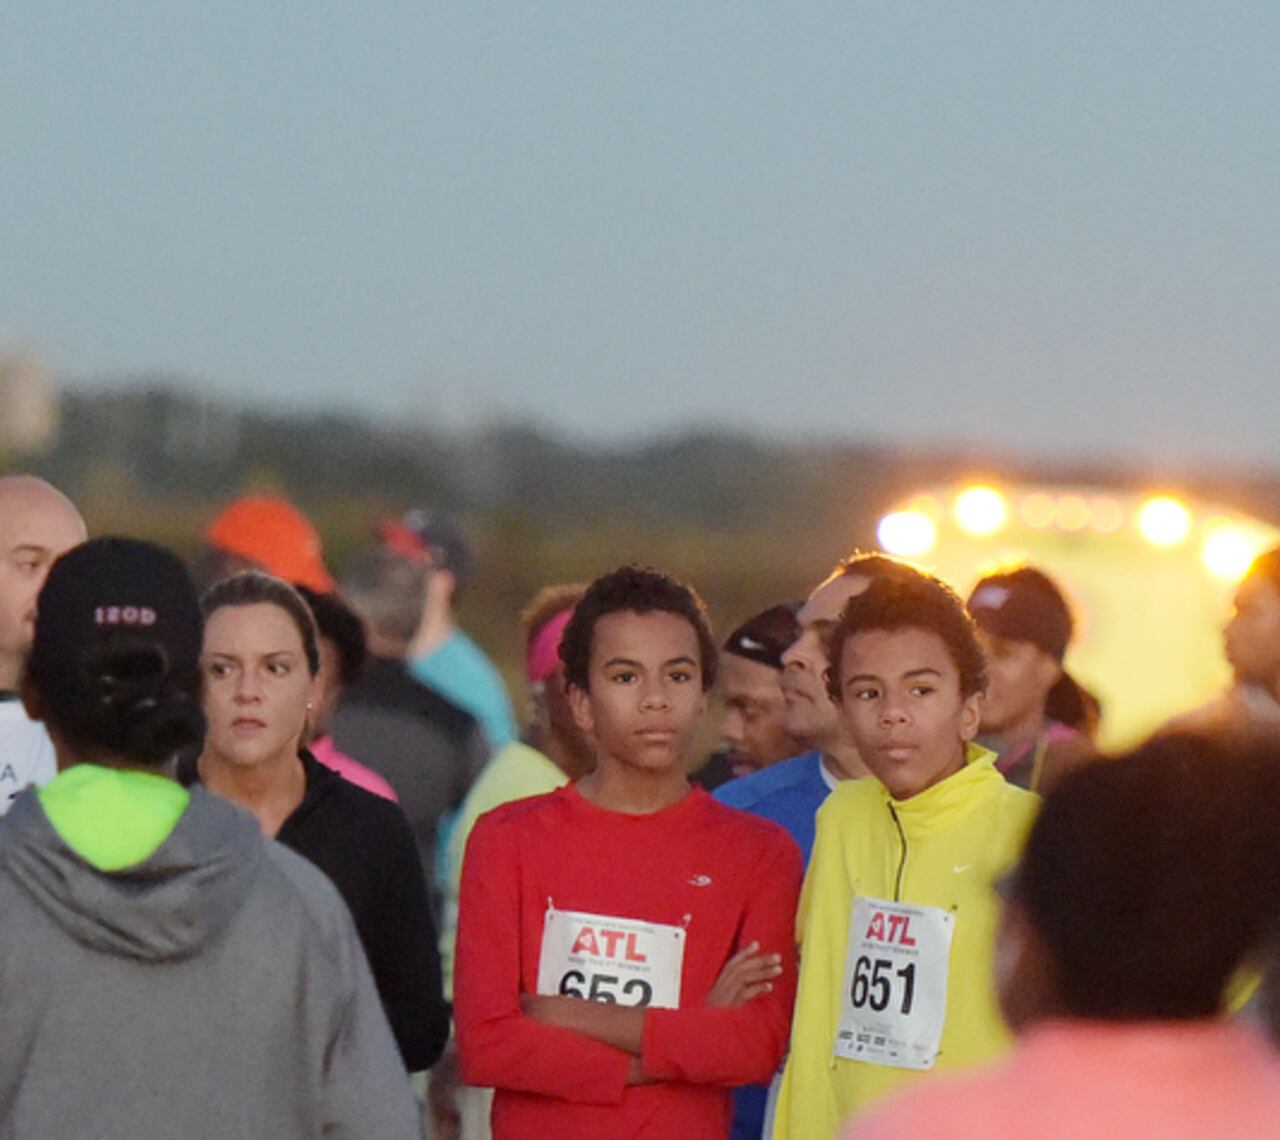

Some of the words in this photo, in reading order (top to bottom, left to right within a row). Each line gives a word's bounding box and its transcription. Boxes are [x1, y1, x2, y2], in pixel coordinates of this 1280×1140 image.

[571, 926, 647, 963] ATL
[865, 911, 916, 947] ATL
[851, 955, 916, 1016] 651
